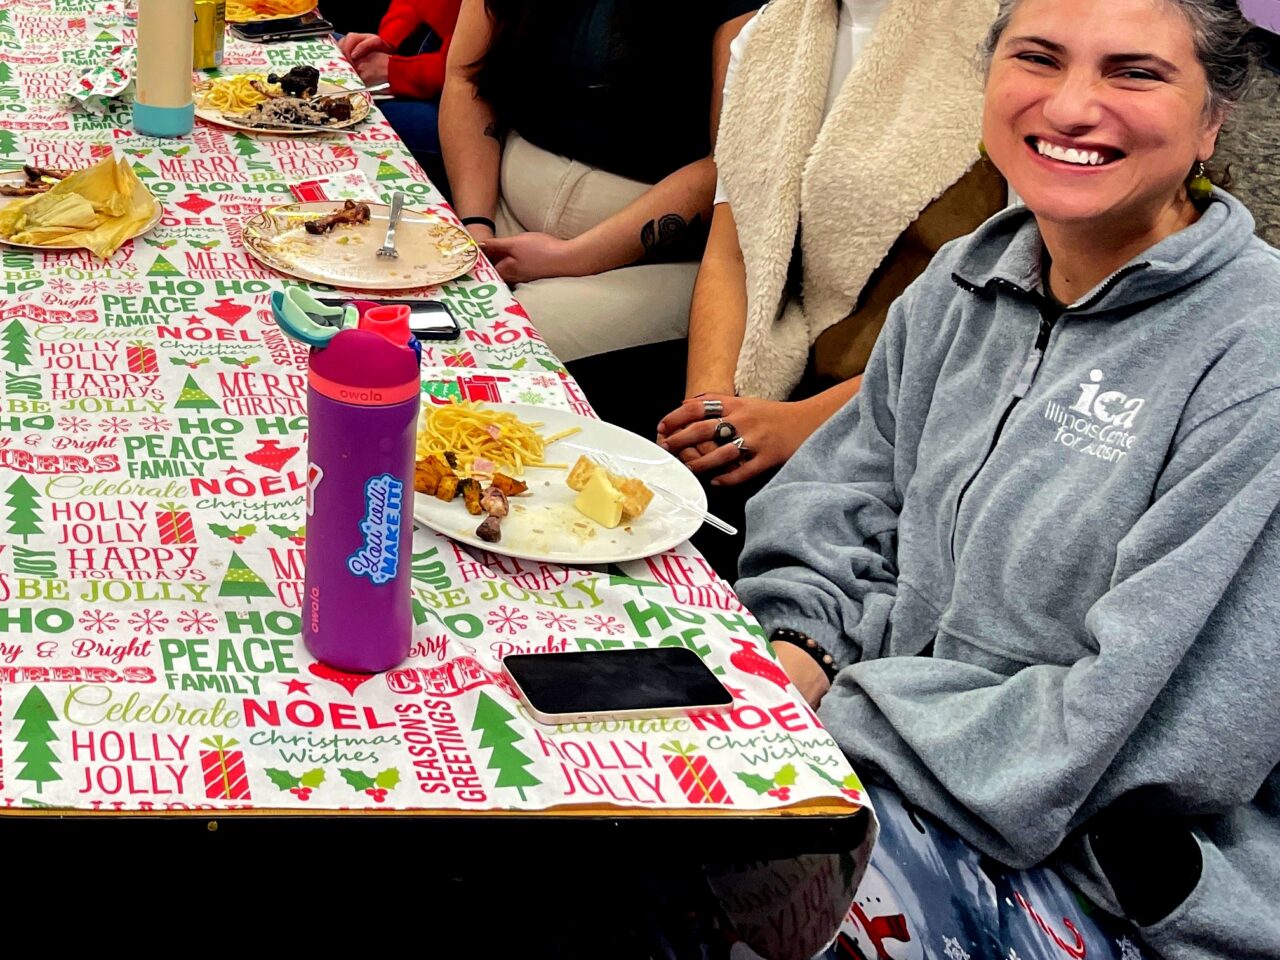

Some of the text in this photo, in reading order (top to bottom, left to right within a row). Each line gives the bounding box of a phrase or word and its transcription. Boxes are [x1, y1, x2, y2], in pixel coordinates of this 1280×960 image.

[158, 156, 241, 173] MERRY
[149, 281, 204, 295] HO
[102, 294, 198, 314] PEACE
[105, 313, 170, 327] FAMILY
[156, 326, 260, 342] NOEL
[39, 341, 120, 356] HOLLY
[42, 355, 119, 371] JOLLY
[51, 373, 160, 390] HAPPY
[51, 387, 162, 401] HOLIDAYS
[339, 389, 383, 402] owala
[1068, 369, 1146, 429] ica
[9, 399, 167, 414] BE JOLLY
[179, 417, 243, 435] HO
[1044, 400, 1100, 439] Illinois
[52, 435, 119, 452] Bright
[1054, 425, 1082, 450] for
[125, 436, 237, 461] PEACE
[128, 461, 204, 478] FAMILY
[46, 478, 188, 499] Celebrate
[190, 472, 308, 497] NOEL
[52, 501, 147, 521] HOLLY
[220, 507, 301, 522] Wishes
[58, 523, 147, 544] JOLLY
[351, 485, 388, 574] You will
[380, 481, 403, 577] MAKE IT!
[69, 548, 199, 571] HAPPY
[17, 579, 210, 603] BE JOLLY
[226, 611, 300, 635] HO
[72, 637, 157, 662] Bright
[160, 638, 298, 673] PEACE
[166, 674, 259, 694] FAMILY
[65, 685, 240, 729] Celebrate
[243, 698, 396, 730] NOEL
[72, 730, 189, 761] HOLLY
[250, 731, 402, 749] Christmas
[395, 703, 450, 794] SEASON'S
[279, 747, 378, 765] Wishes
[424, 699, 487, 803] GREETINGS
[80, 765, 188, 795] JOLLY
[560, 763, 666, 803] JOLLY
